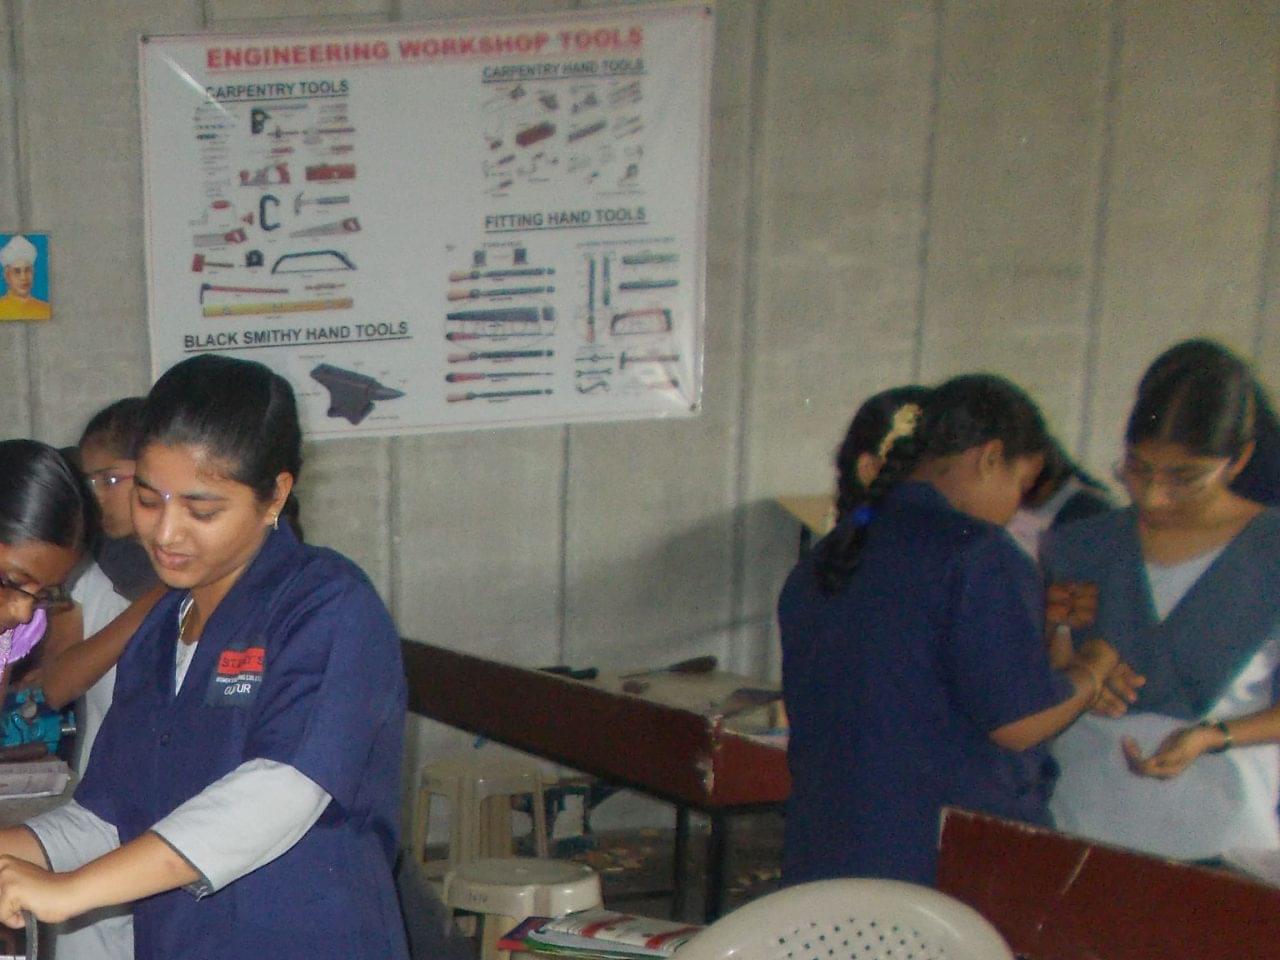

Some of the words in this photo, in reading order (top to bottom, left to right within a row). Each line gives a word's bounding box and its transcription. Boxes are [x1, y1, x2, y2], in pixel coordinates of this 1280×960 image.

[207, 42, 389, 68] ENGINEERING
[399, 34, 548, 58] WORKSHOP
[561, 28, 642, 50] TOOLS
[482, 62, 560, 79] CARPENTRY
[563, 60, 597, 75] HAND
[603, 58, 645, 73] TOOLS
[205, 82, 296, 99] CARPENTRY
[300, 79, 350, 95] TOOLS
[485, 212, 544, 229] FITTING
[548, 209, 591, 225] HAND
[595, 206, 646, 222] TOOLS
[184, 331, 238, 349] BLACK
[243, 328, 303, 345] SMITHY
[306, 325, 351, 341] HAND
[356, 321, 409, 338] TOOLS
